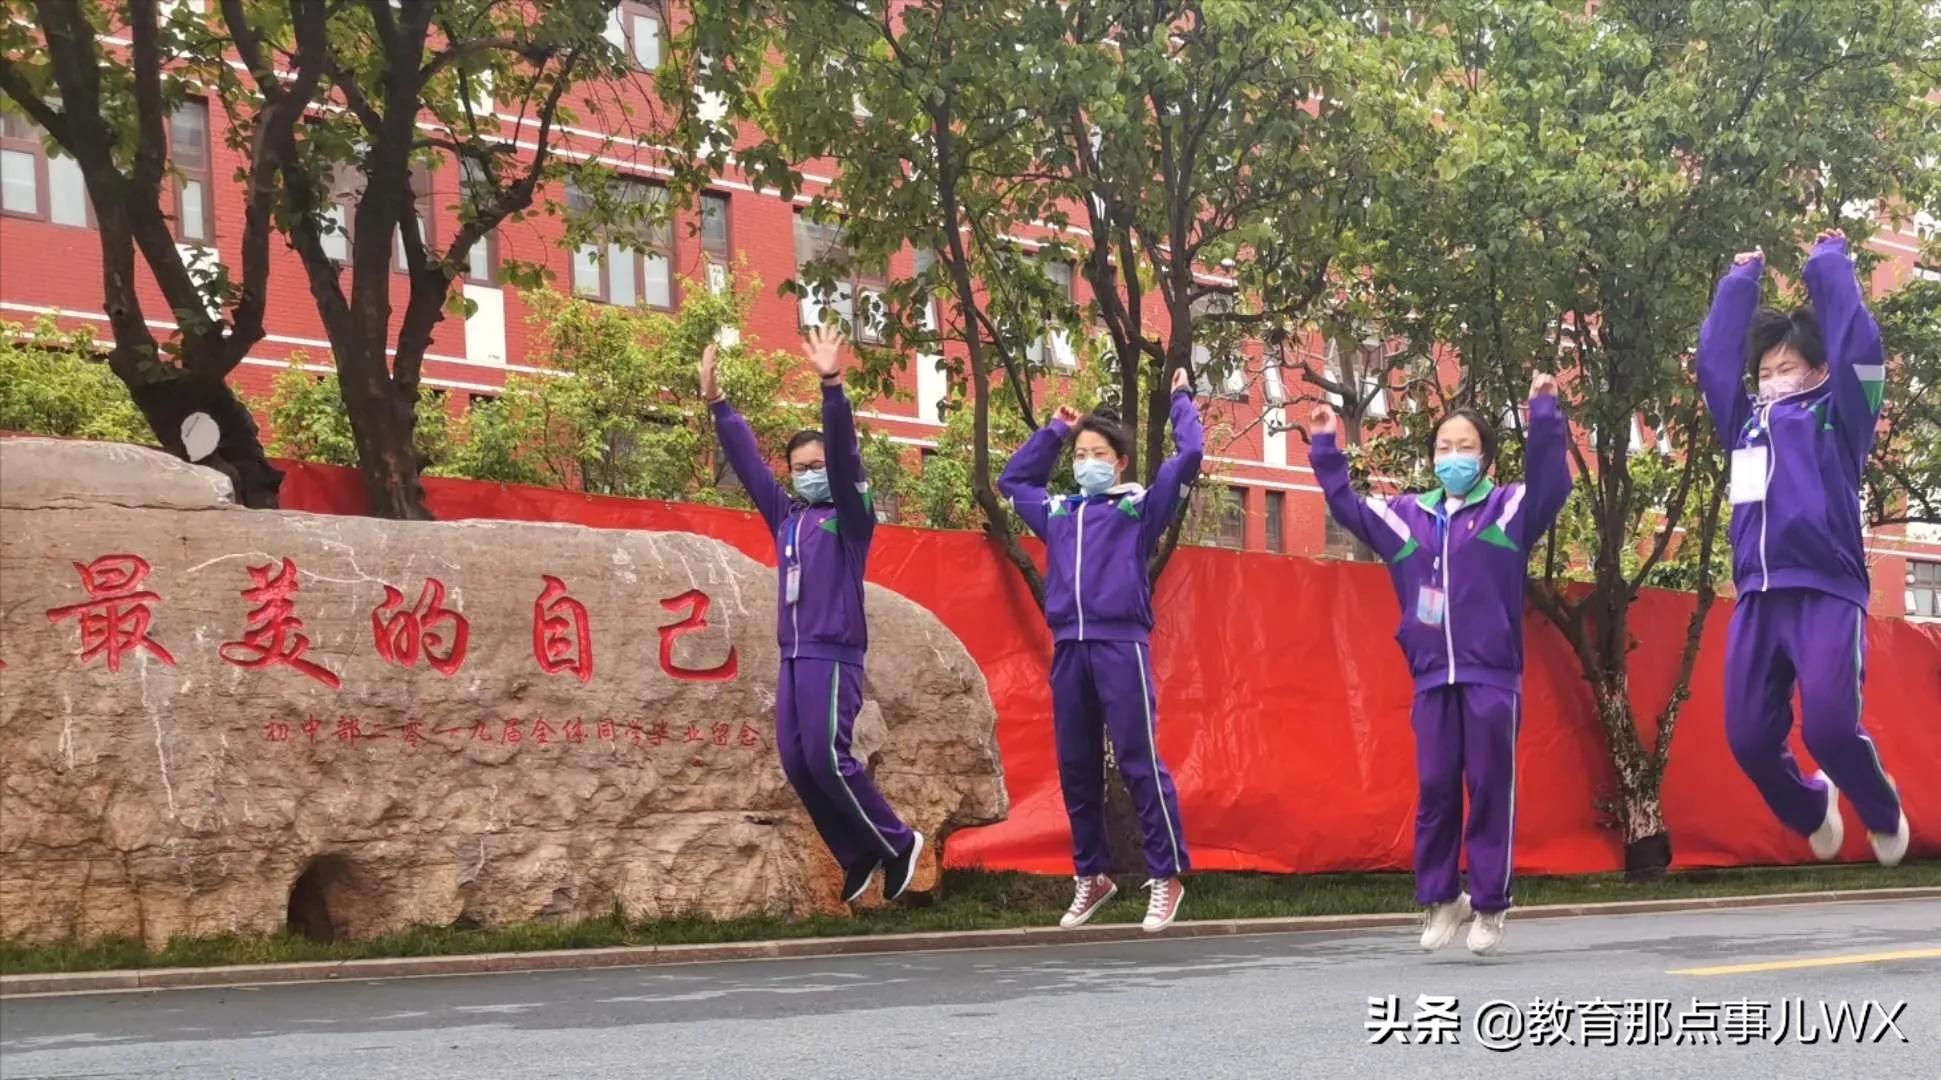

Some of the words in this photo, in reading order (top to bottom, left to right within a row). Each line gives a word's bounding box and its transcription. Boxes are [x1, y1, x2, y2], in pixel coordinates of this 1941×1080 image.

[0, 553, 738, 689] 最美的自己
